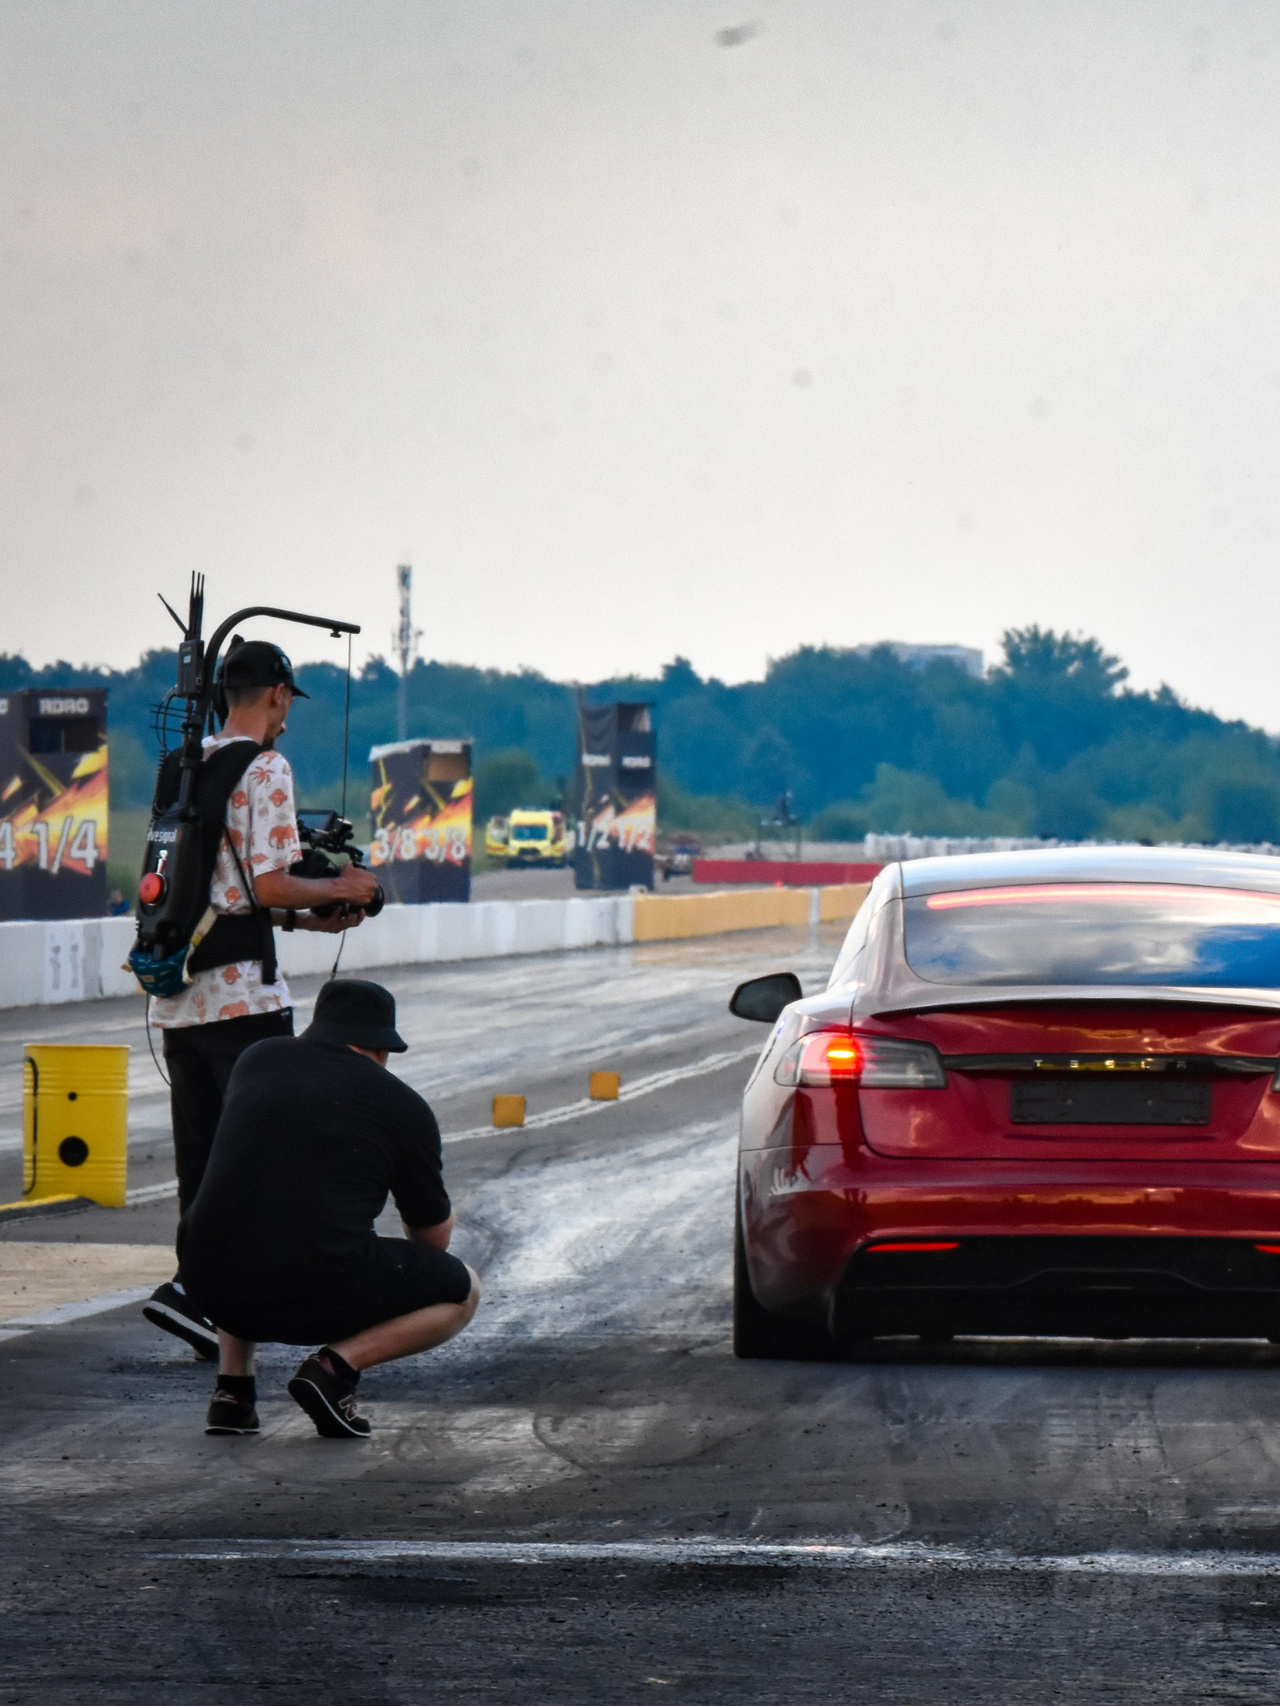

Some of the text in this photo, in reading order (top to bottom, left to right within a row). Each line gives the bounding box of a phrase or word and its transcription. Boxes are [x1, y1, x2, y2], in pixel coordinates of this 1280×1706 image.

[31, 816, 98, 875] 1/4
[374, 826, 416, 862] 3/8
[424, 827, 467, 863] 3/8
[1034, 1059, 1187, 1069] TESLA
